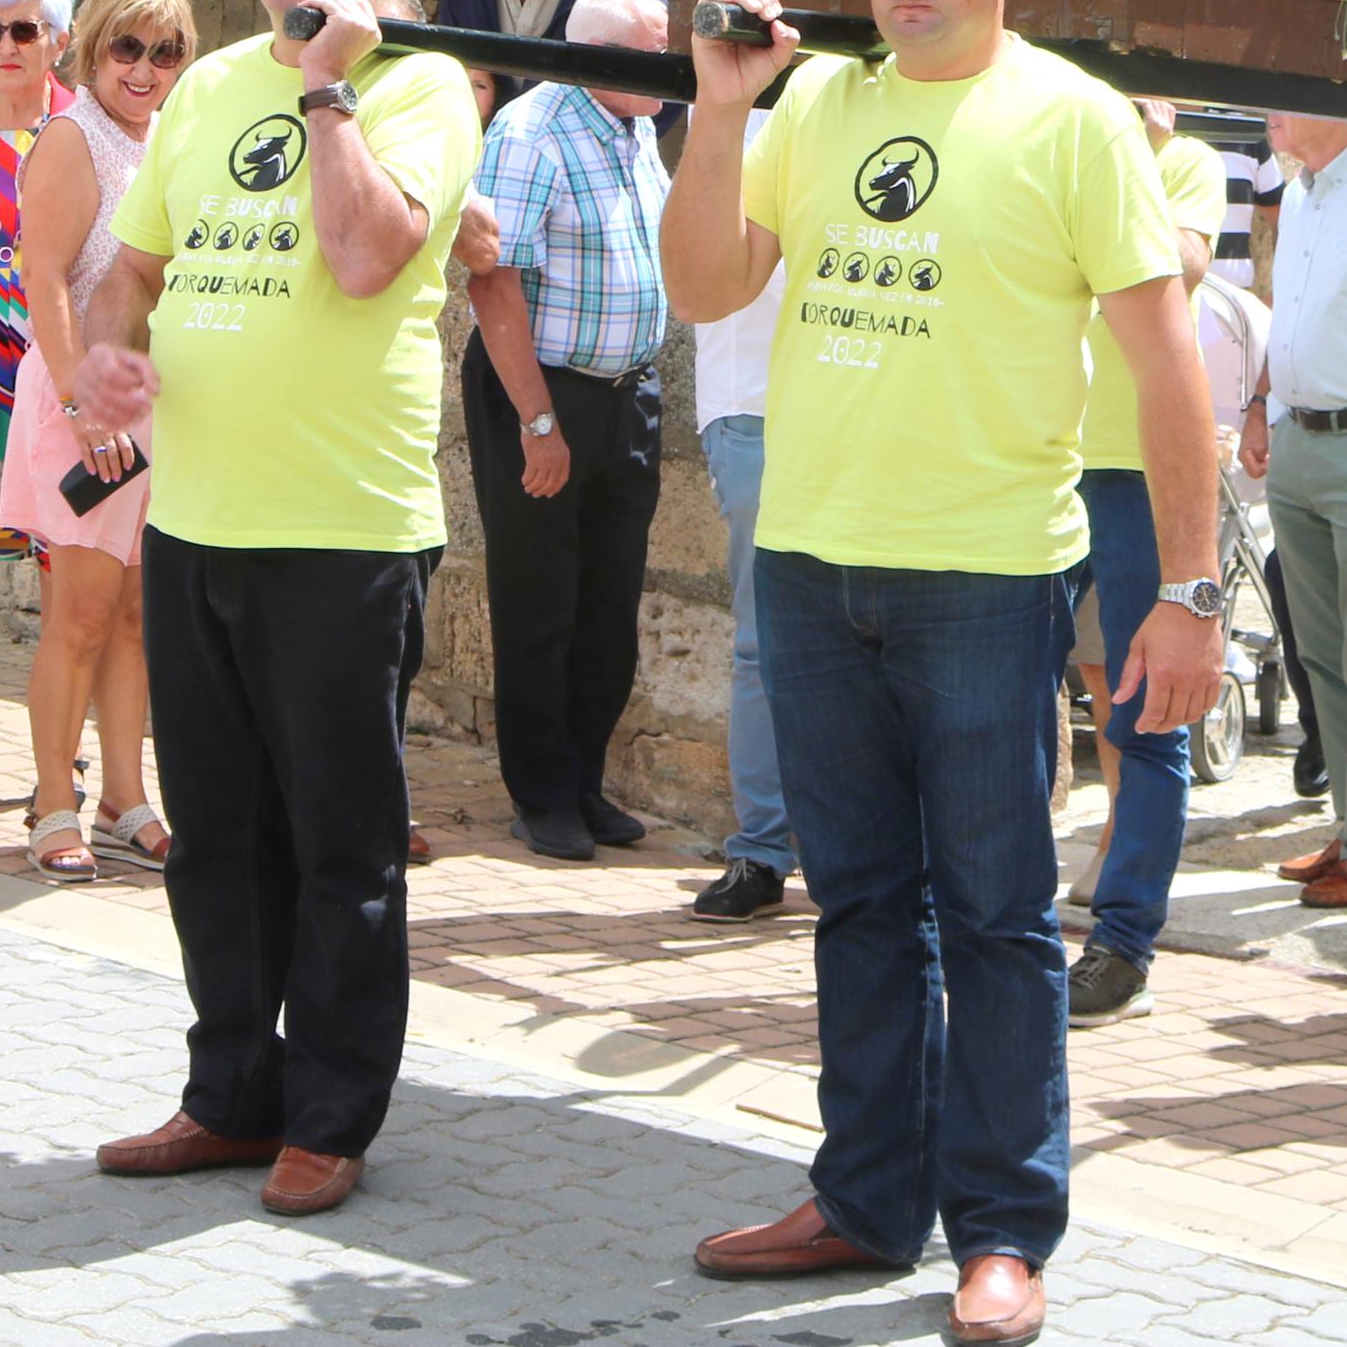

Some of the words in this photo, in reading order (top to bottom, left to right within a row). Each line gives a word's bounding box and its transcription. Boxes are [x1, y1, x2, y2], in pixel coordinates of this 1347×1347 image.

[826, 223, 849, 245] SE
[854, 225, 940, 254] BUSCAN
[168, 274, 291, 299] TORQUEMADA
[182, 302, 246, 331] 2022
[800, 301, 932, 339] TORQUEMADA
[816, 333, 883, 369] 2022
